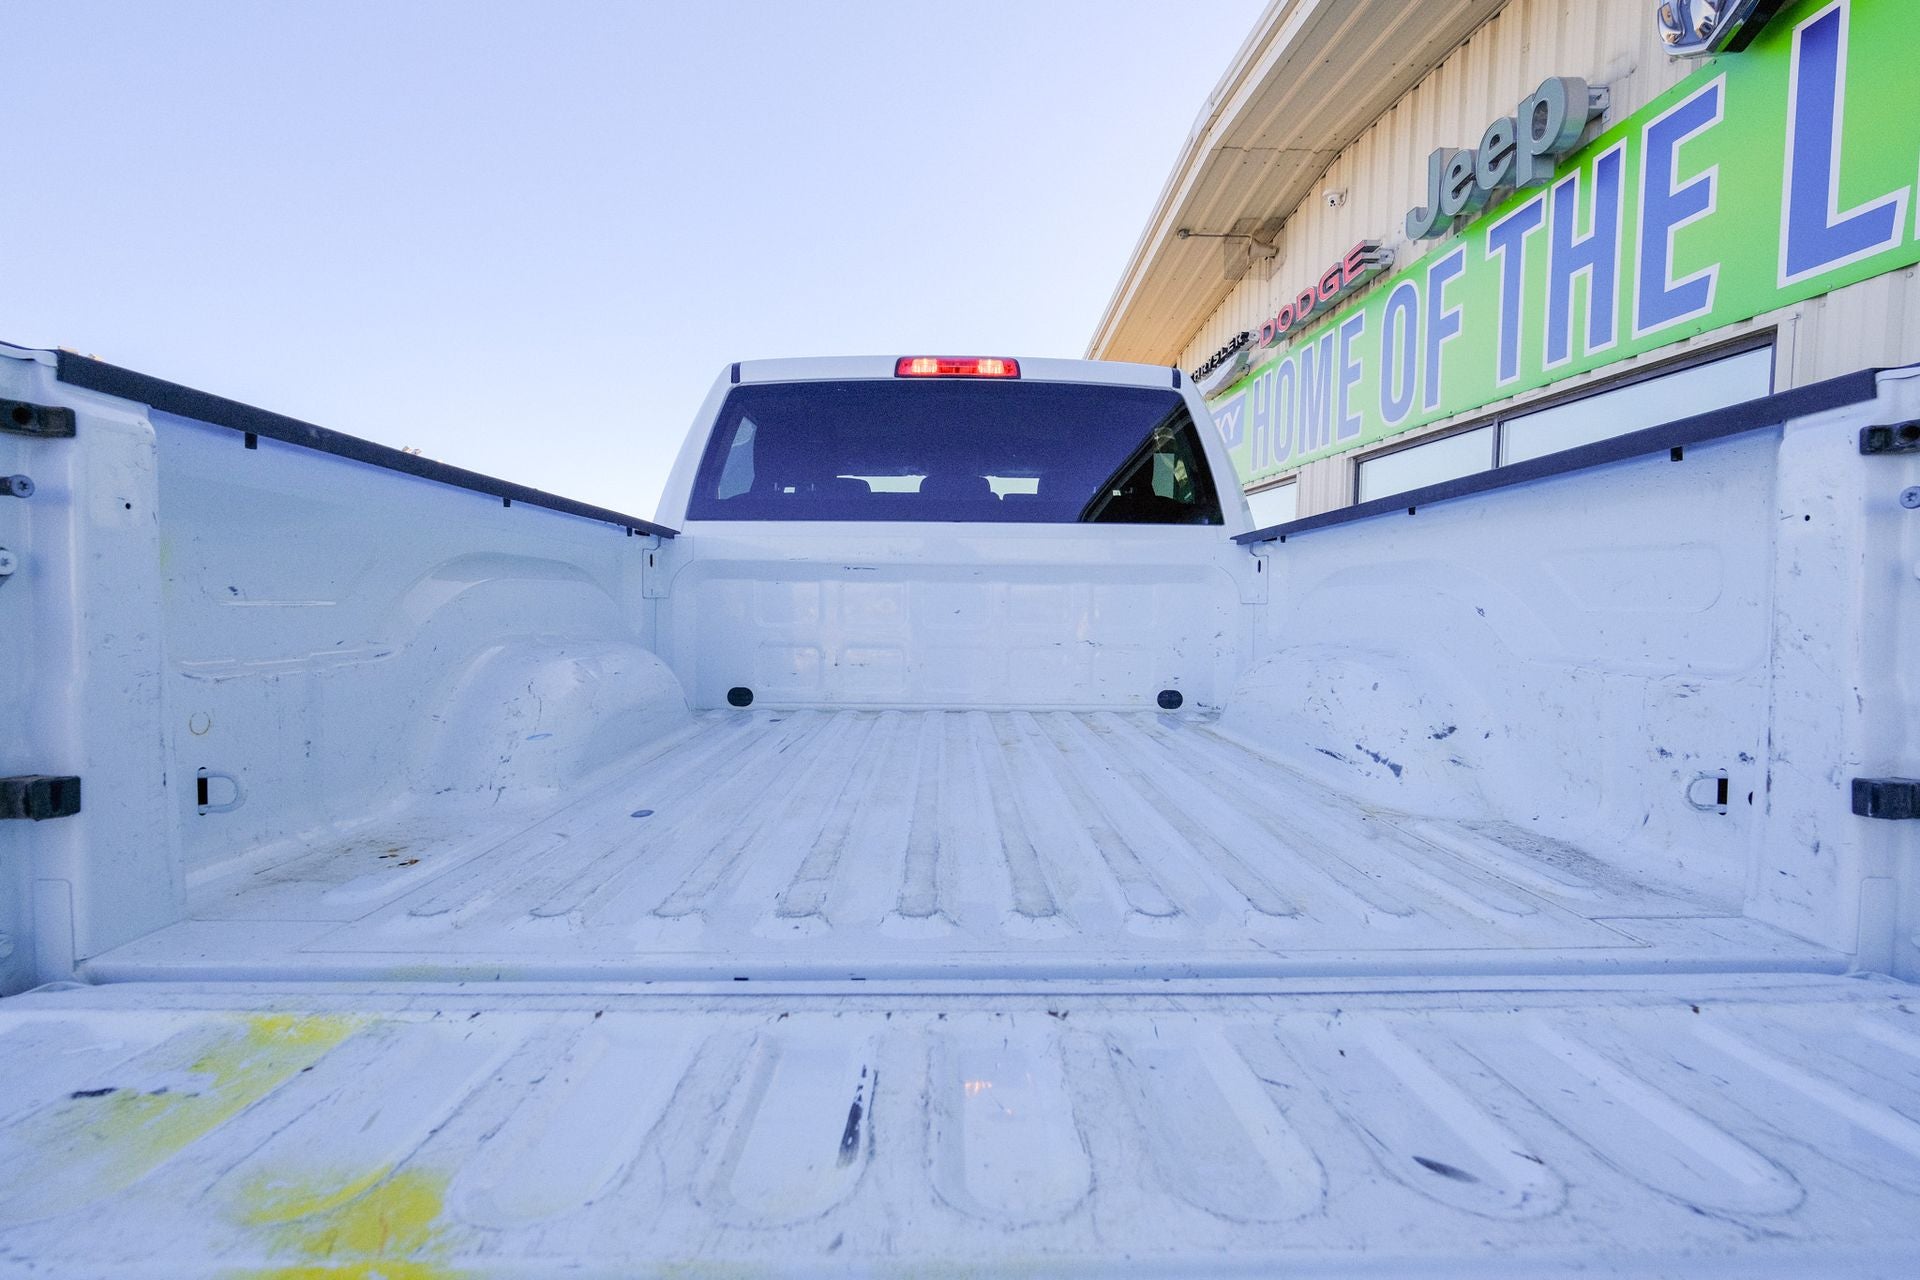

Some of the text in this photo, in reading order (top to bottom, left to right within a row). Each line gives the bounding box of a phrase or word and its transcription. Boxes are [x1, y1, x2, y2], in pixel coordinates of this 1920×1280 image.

[1405, 76, 1588, 240] Jeep
[1251, 0, 1920, 473] HOME OF THE L
[1259, 240, 1379, 348] DODGE
[1190, 331, 1249, 383] HRYSLER
